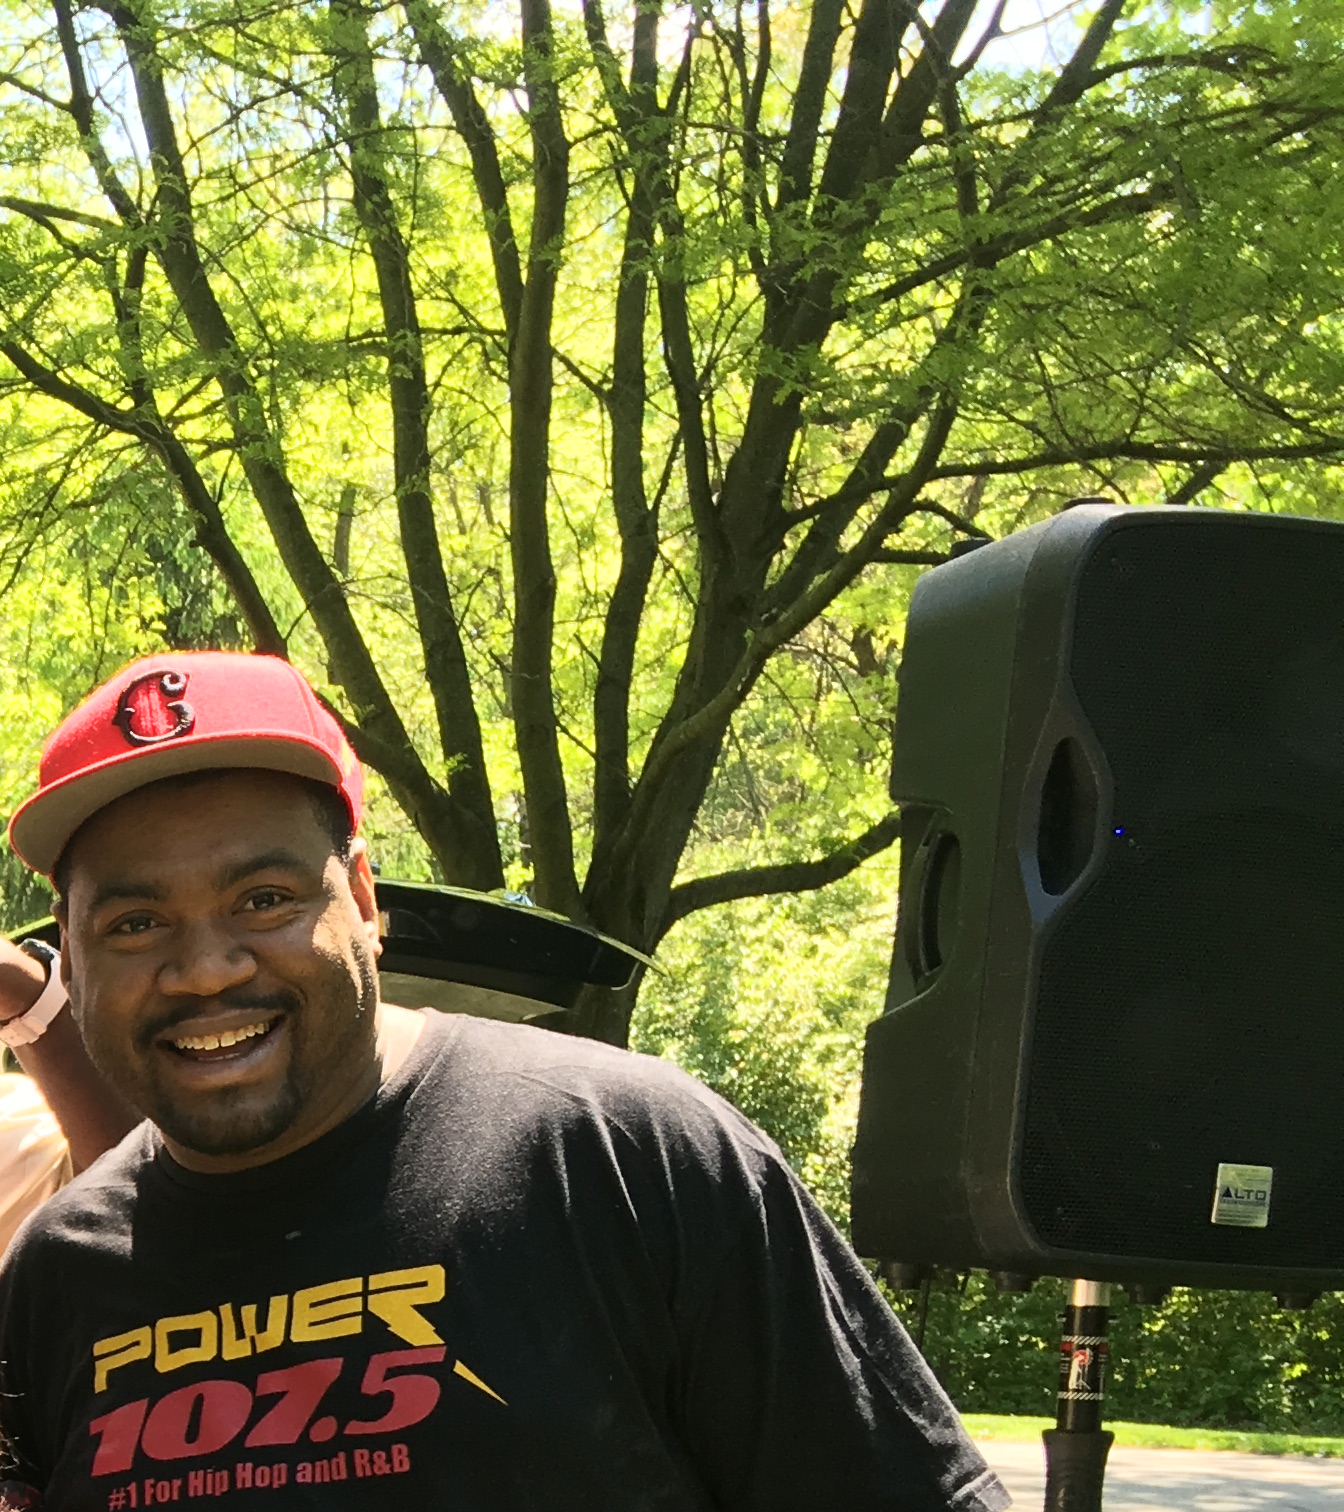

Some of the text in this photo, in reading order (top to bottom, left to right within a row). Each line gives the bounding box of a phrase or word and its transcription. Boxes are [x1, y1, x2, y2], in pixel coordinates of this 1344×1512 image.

[93, 1264, 446, 1394] POWER
[88, 1346, 448, 1478] 107.5
[108, 1443, 411, 1511] #1 For Hip Hop and R&B
